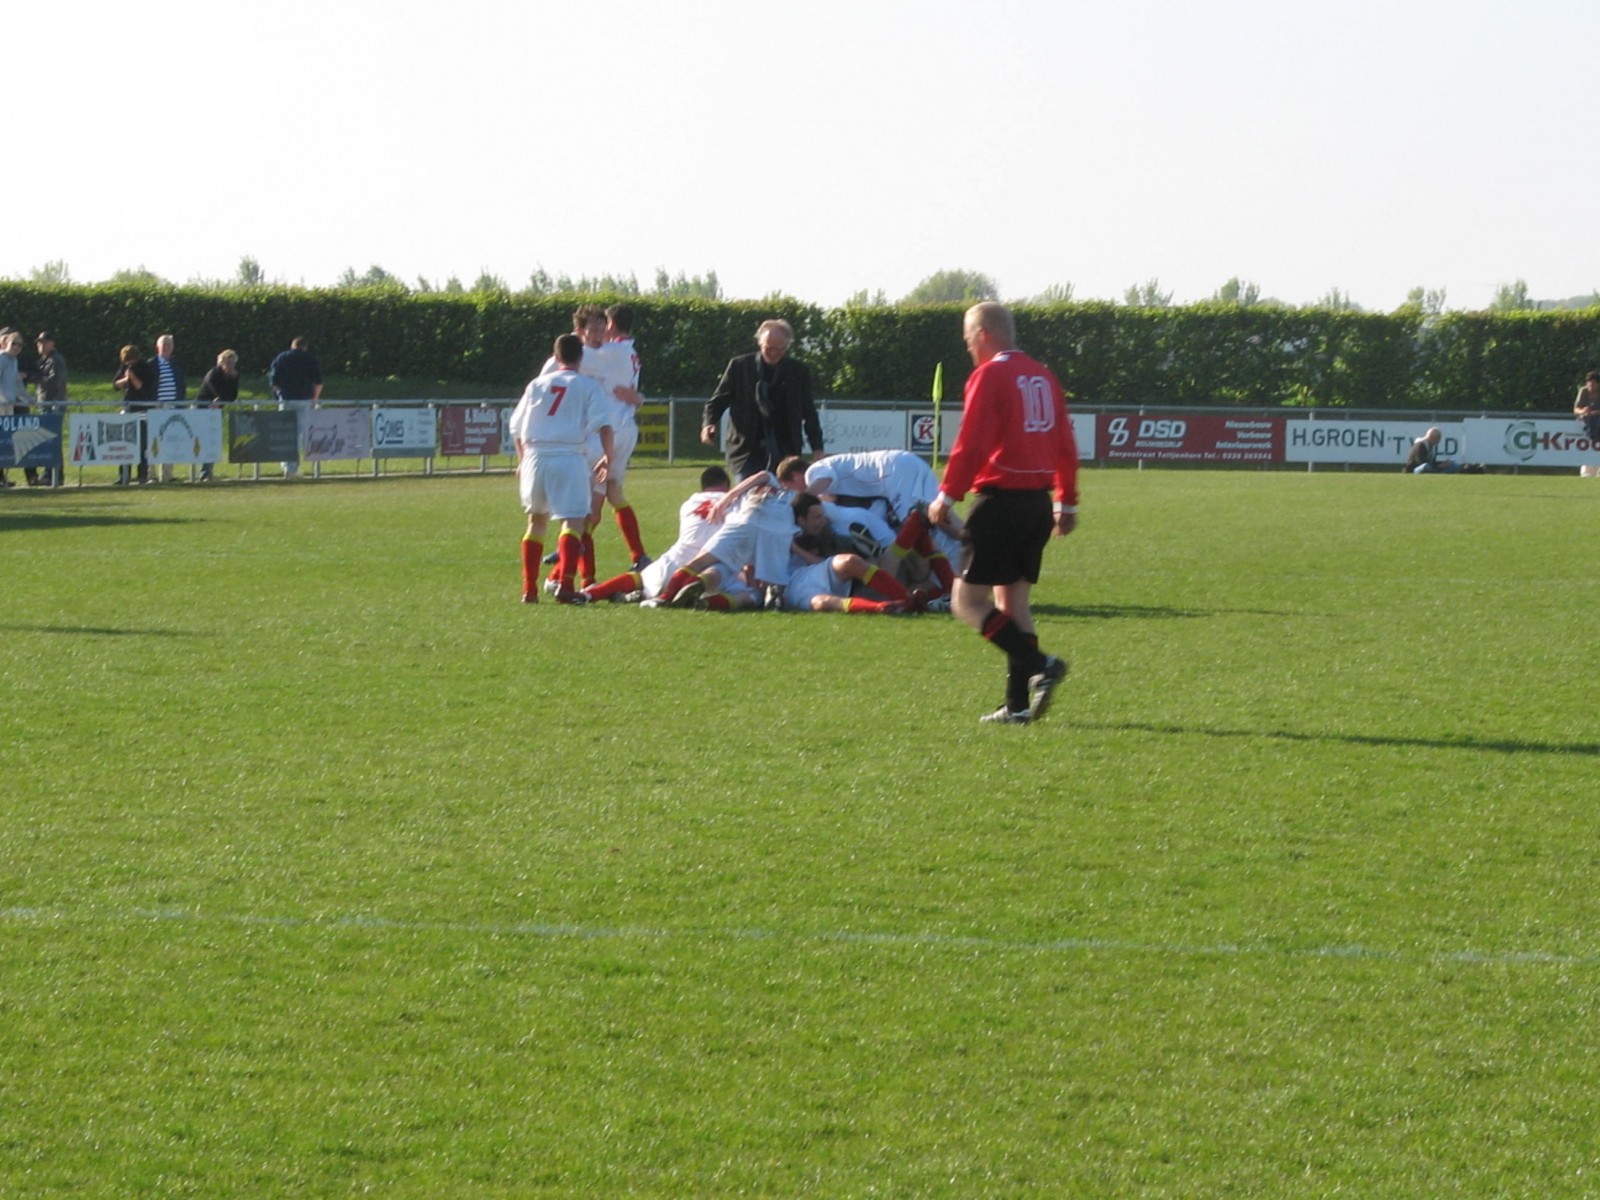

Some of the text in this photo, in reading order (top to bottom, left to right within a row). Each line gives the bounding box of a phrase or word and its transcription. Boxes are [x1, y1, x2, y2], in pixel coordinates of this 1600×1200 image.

[547, 386, 567, 416] 7
[1016, 375, 1055, 432] 10
[918, 424, 935, 440] K
[1138, 420, 1187, 438] DSD
